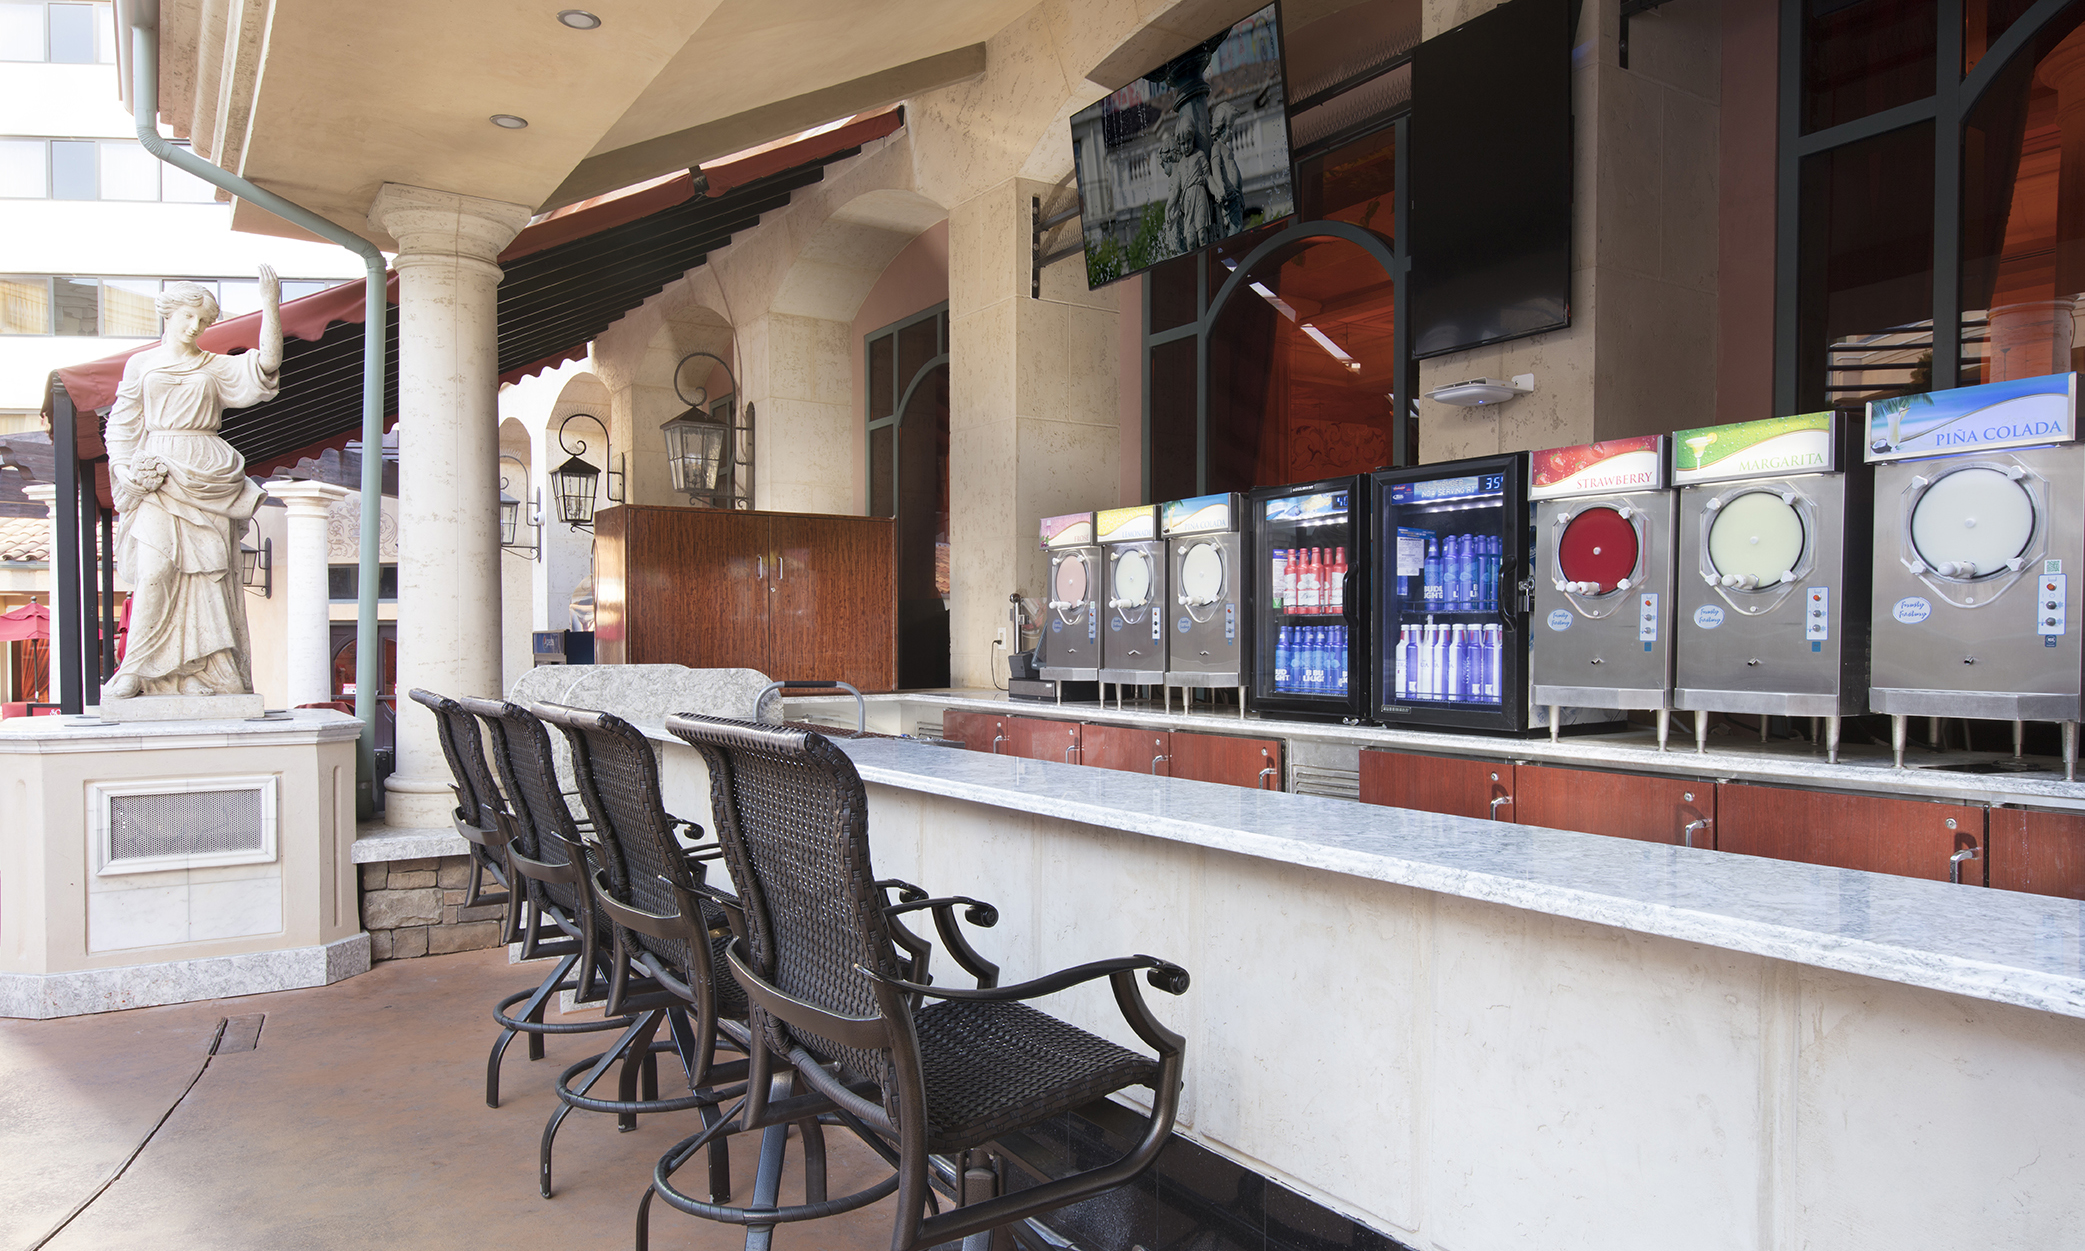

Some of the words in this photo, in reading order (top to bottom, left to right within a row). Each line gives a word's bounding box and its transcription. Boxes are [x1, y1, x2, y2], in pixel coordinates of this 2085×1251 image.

[1936, 429, 1978, 446] PIÑA
[1983, 420, 2062, 441] COLADA
[1738, 453, 1824, 472] MARGARITA
[1576, 471, 1653, 490] STRAWBERRY
[1200, 518, 1227, 530] COLADA
[1122, 529, 1152, 539] LEMONADE
